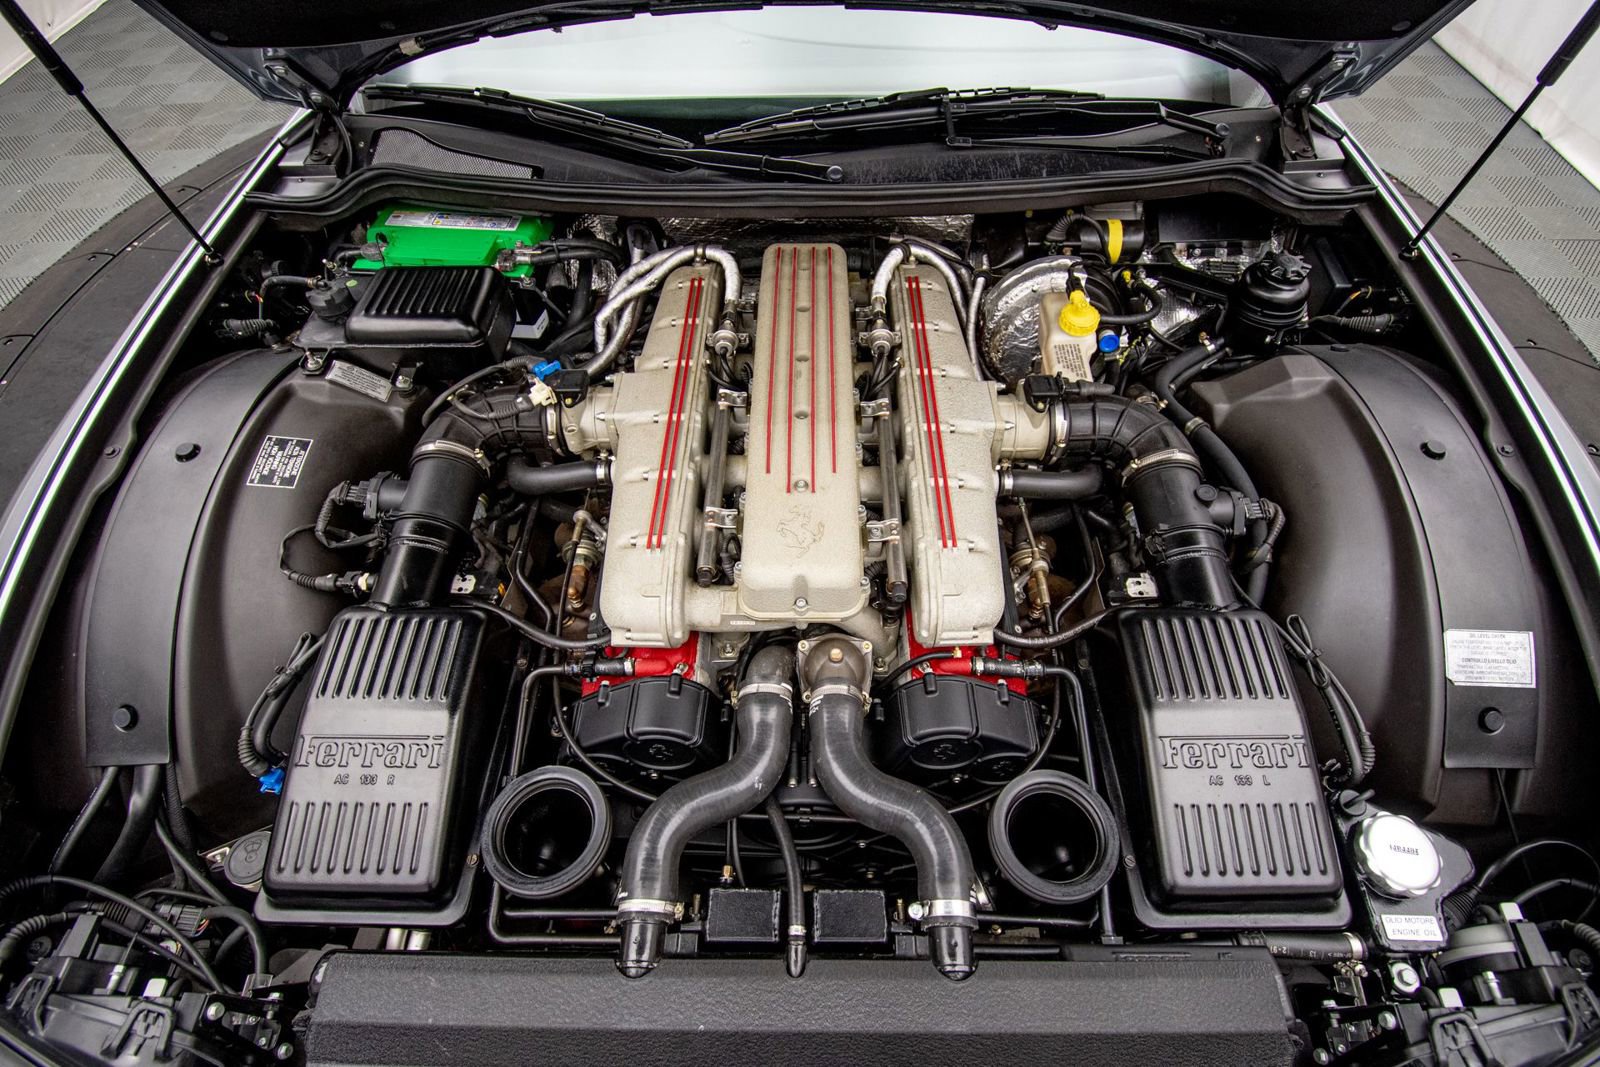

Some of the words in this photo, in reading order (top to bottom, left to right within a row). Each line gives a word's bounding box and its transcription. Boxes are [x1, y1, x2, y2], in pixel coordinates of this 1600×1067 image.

[294, 734, 445, 769] Ferrari
[1158, 734, 1311, 769] Ferrari
[333, 773, 349, 785] AC
[360, 773, 378, 786] 133
[387, 774, 396, 786] R
[1209, 775, 1224, 786] AC
[1234, 775, 1253, 786] 133
[1262, 775, 1271, 786] L
[1385, 916, 1403, 924] OLIO
[1404, 917, 1434, 925] MOTORE
[1392, 928, 1420, 936] ENGINE
[1423, 929, 1438, 937] OIL
